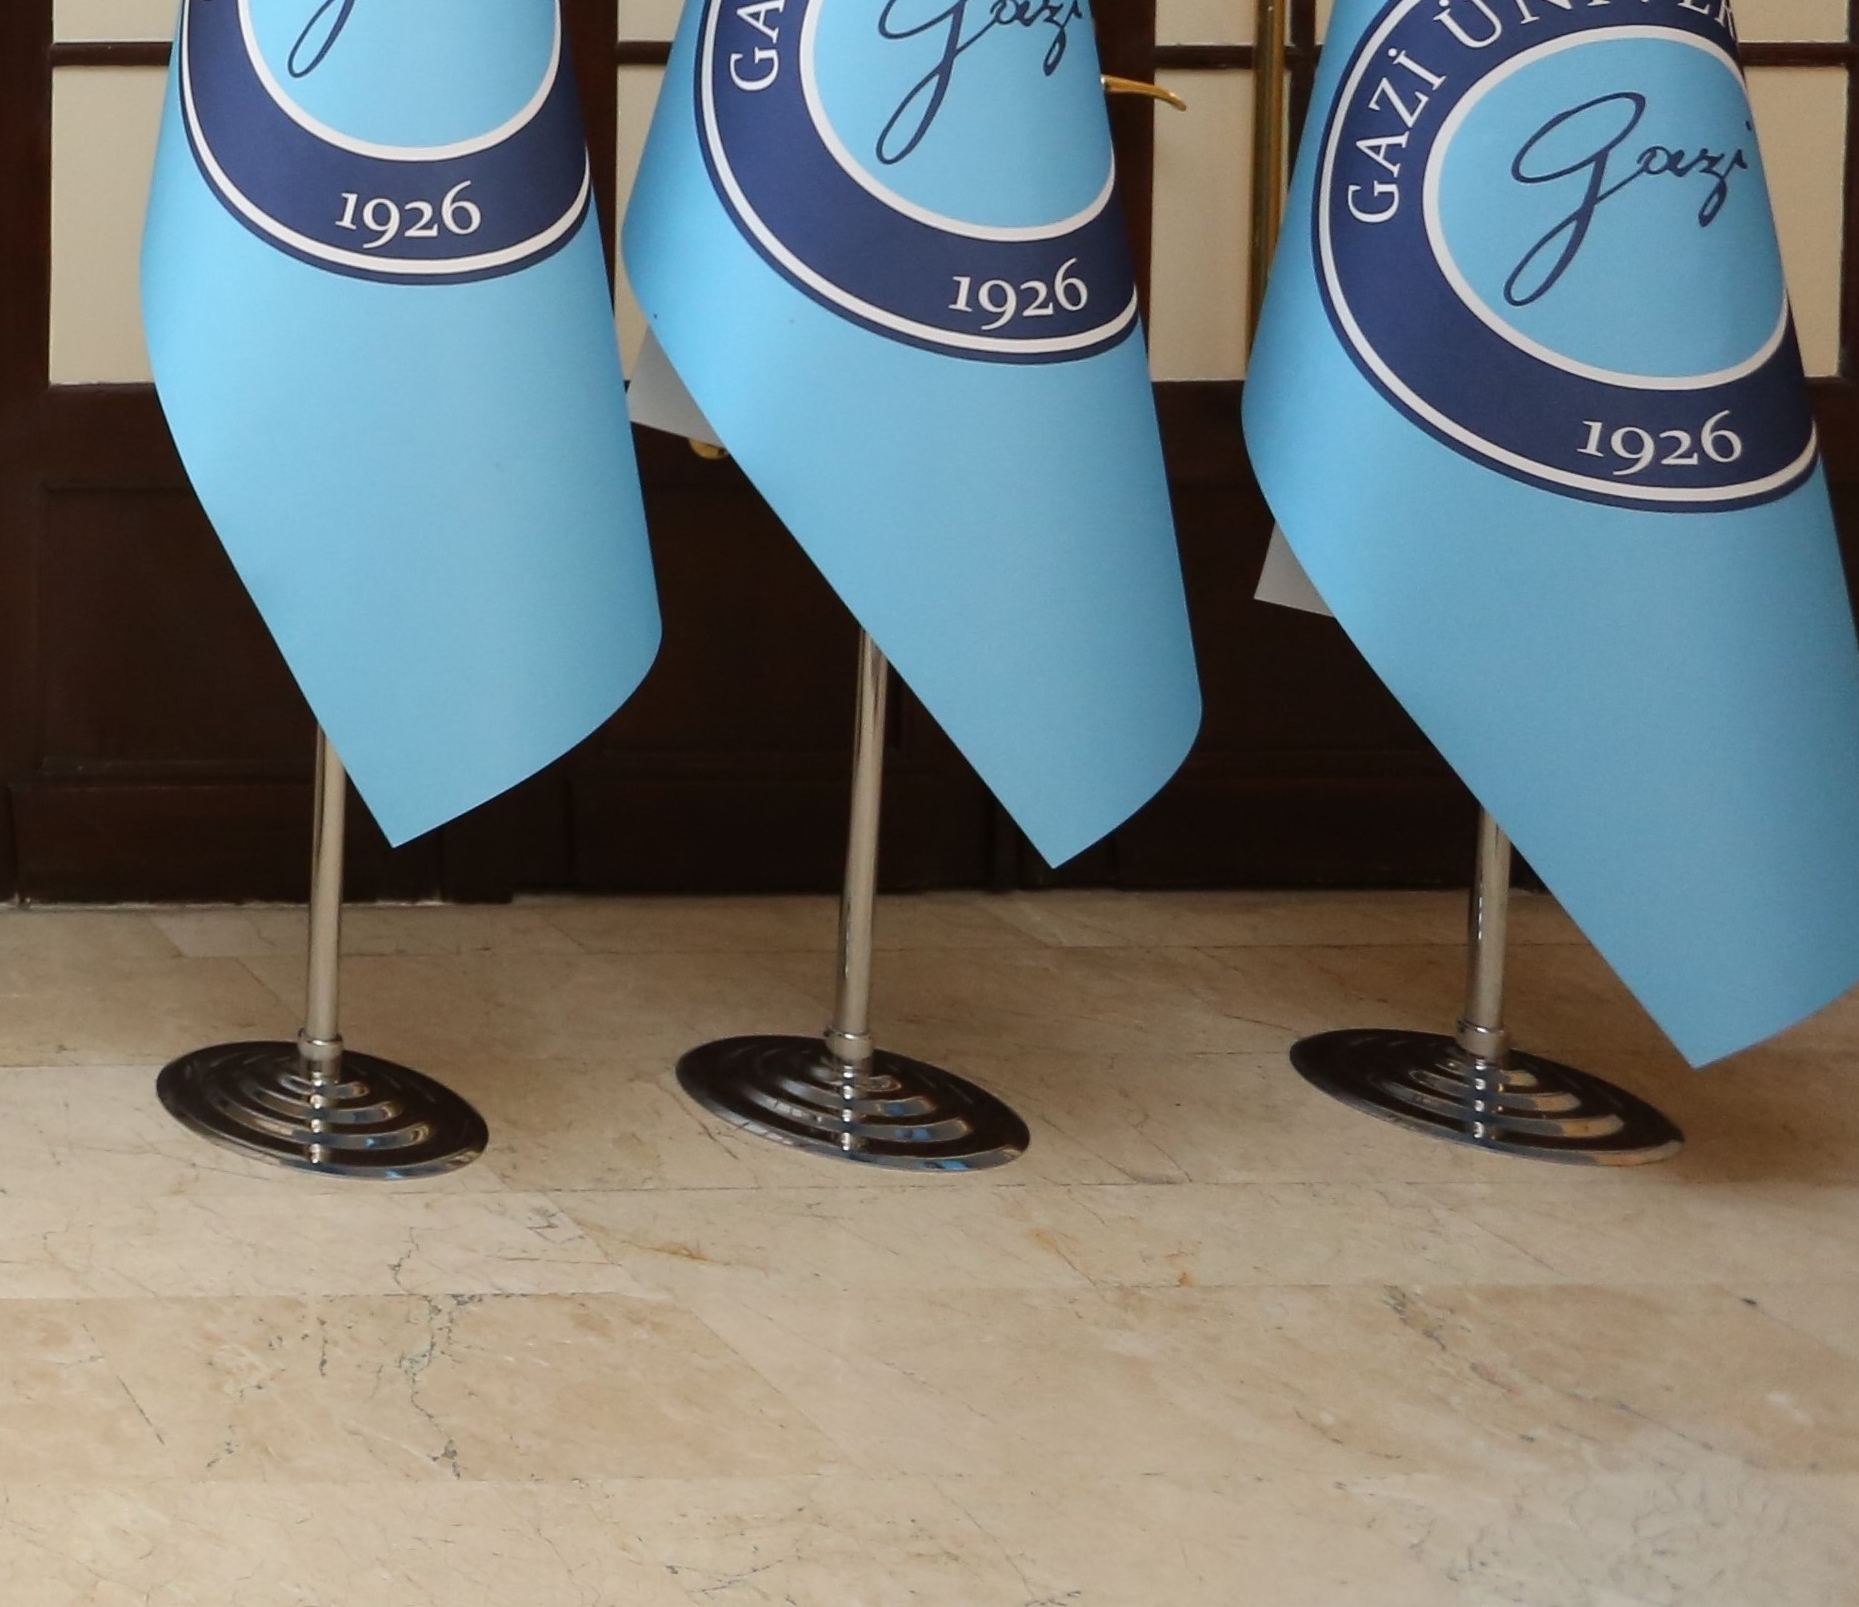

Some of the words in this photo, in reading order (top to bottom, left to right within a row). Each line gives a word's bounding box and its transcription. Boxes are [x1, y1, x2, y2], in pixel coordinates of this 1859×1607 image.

[1346, 46, 1447, 225] GAZİ
[334, 179, 482, 248] 1926
[948, 257, 1089, 331] 1926
[1575, 410, 1744, 476] 1926
